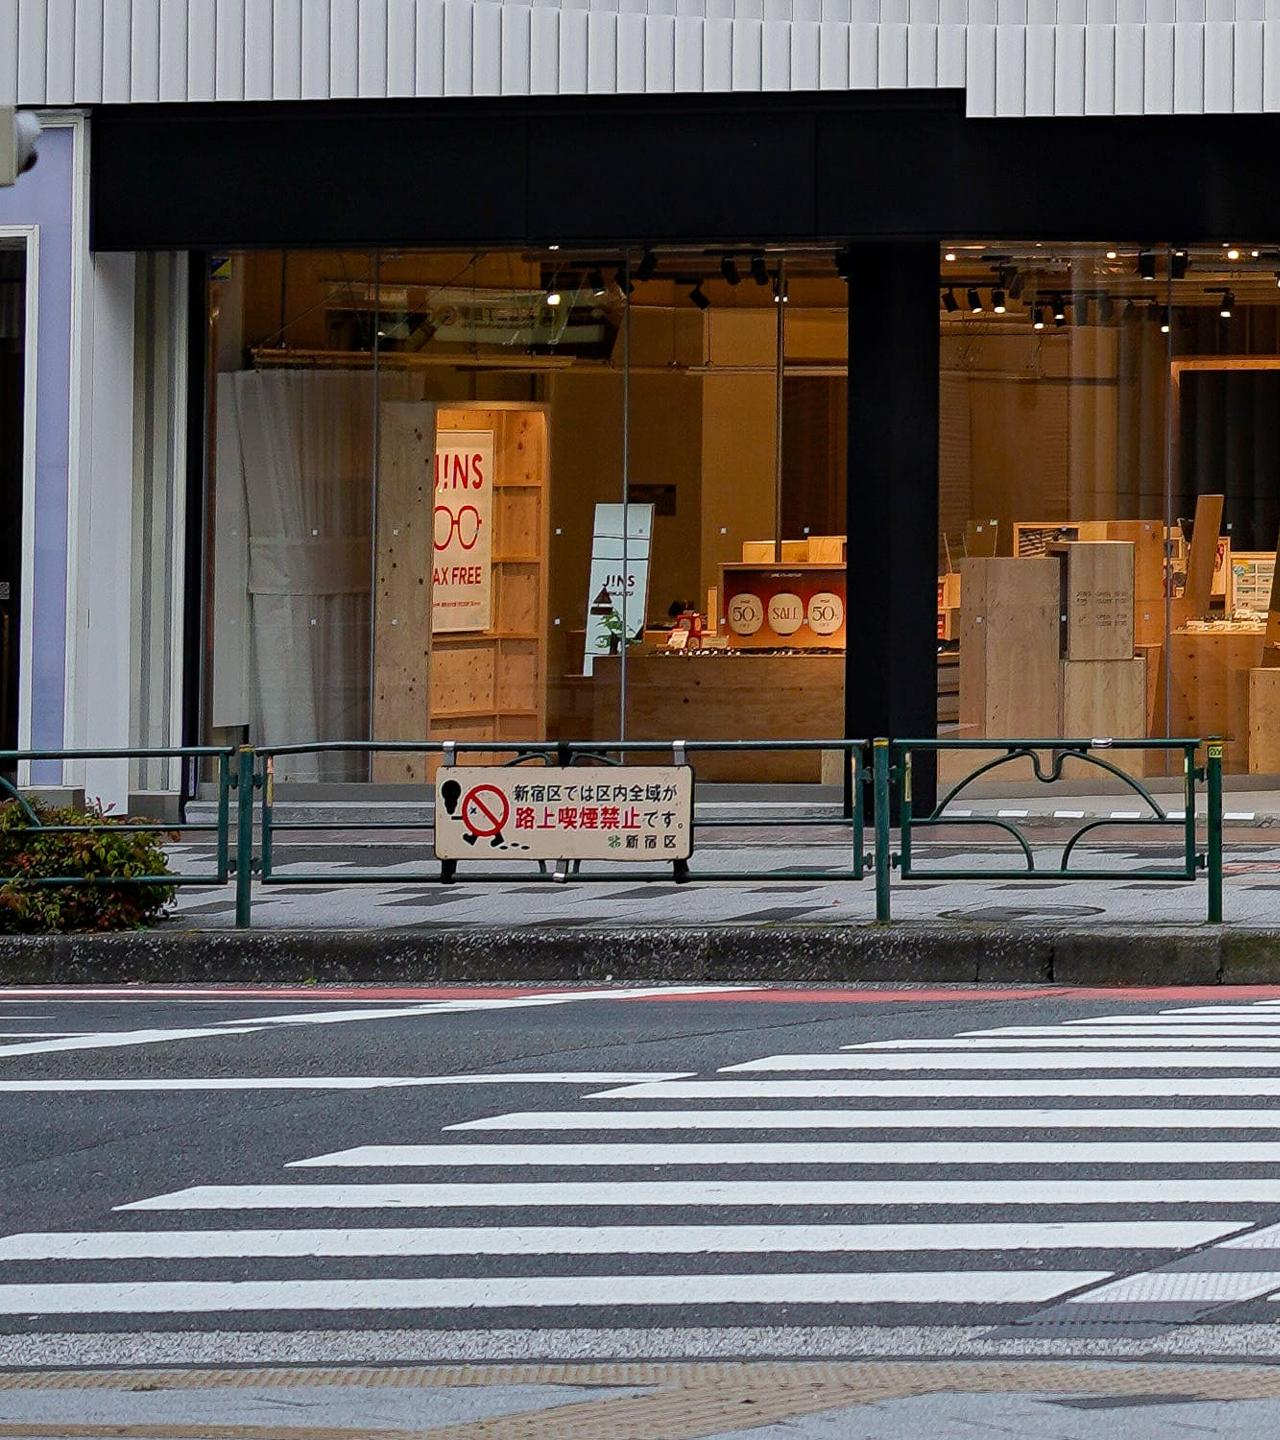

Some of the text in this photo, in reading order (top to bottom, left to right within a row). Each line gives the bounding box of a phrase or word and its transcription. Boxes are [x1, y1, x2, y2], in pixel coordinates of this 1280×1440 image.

[451, 566, 482, 585] FREE
[513, 784, 678, 803] 新宿区では区内全域が
[514, 806, 684, 831] 路上喫煙禁止です。
[625, 834, 678, 850] 新宿区
